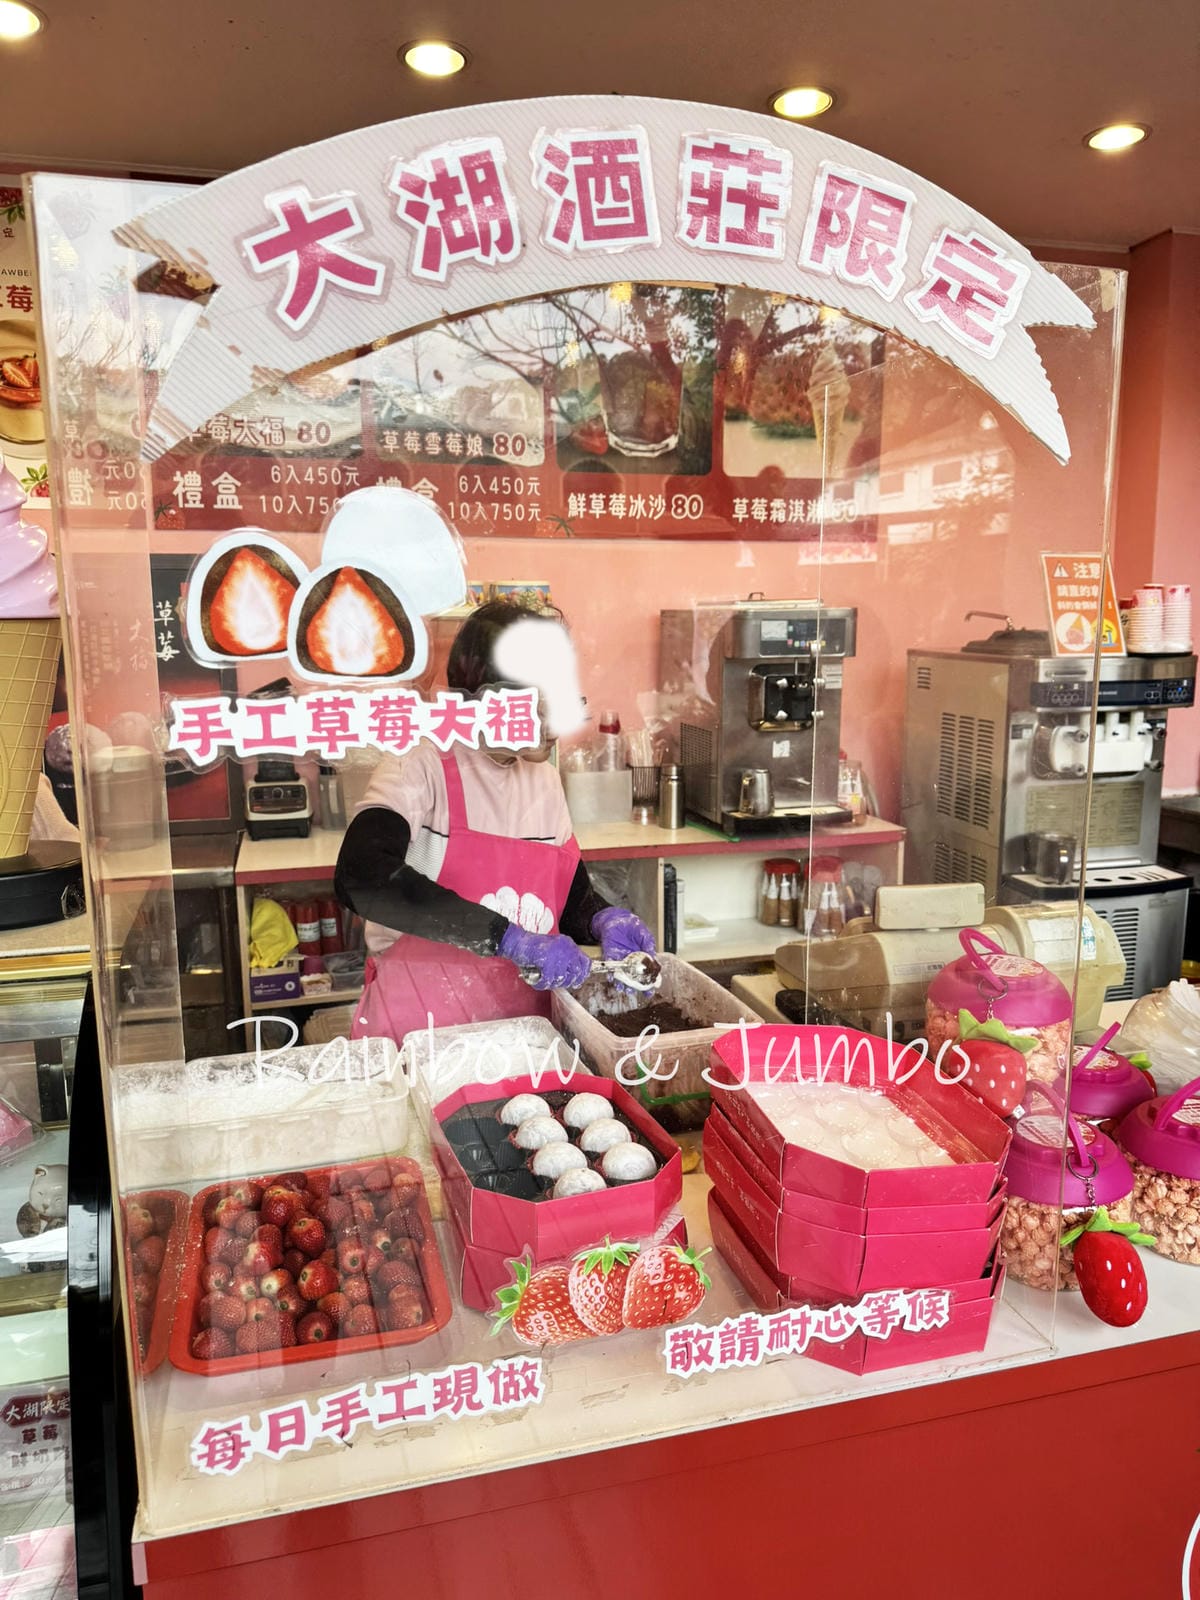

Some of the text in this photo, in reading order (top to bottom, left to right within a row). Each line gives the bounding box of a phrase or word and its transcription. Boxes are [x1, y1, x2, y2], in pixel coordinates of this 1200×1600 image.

[250, 137, 1019, 348] 大湖酒莊限定
[0, 284, 33, 312] 莓
[297, 420, 332, 447] 80
[382, 430, 528, 457] 草莓雪莓娘 80
[271, 465, 360, 486] 6入450元
[459, 475, 541, 496] 6入450元
[172, 470, 244, 510] 禮盒
[448, 501, 541, 522] 10入750元
[567, 492, 704, 520] 鮮草莓冰沙 80
[177, 693, 536, 757] 手工草莓大福
[668, 1289, 950, 1373] 敬請耐心等候
[6, 1398, 70, 1422] 大湖限定
[196, 1360, 541, 1472] 每日手工現做
